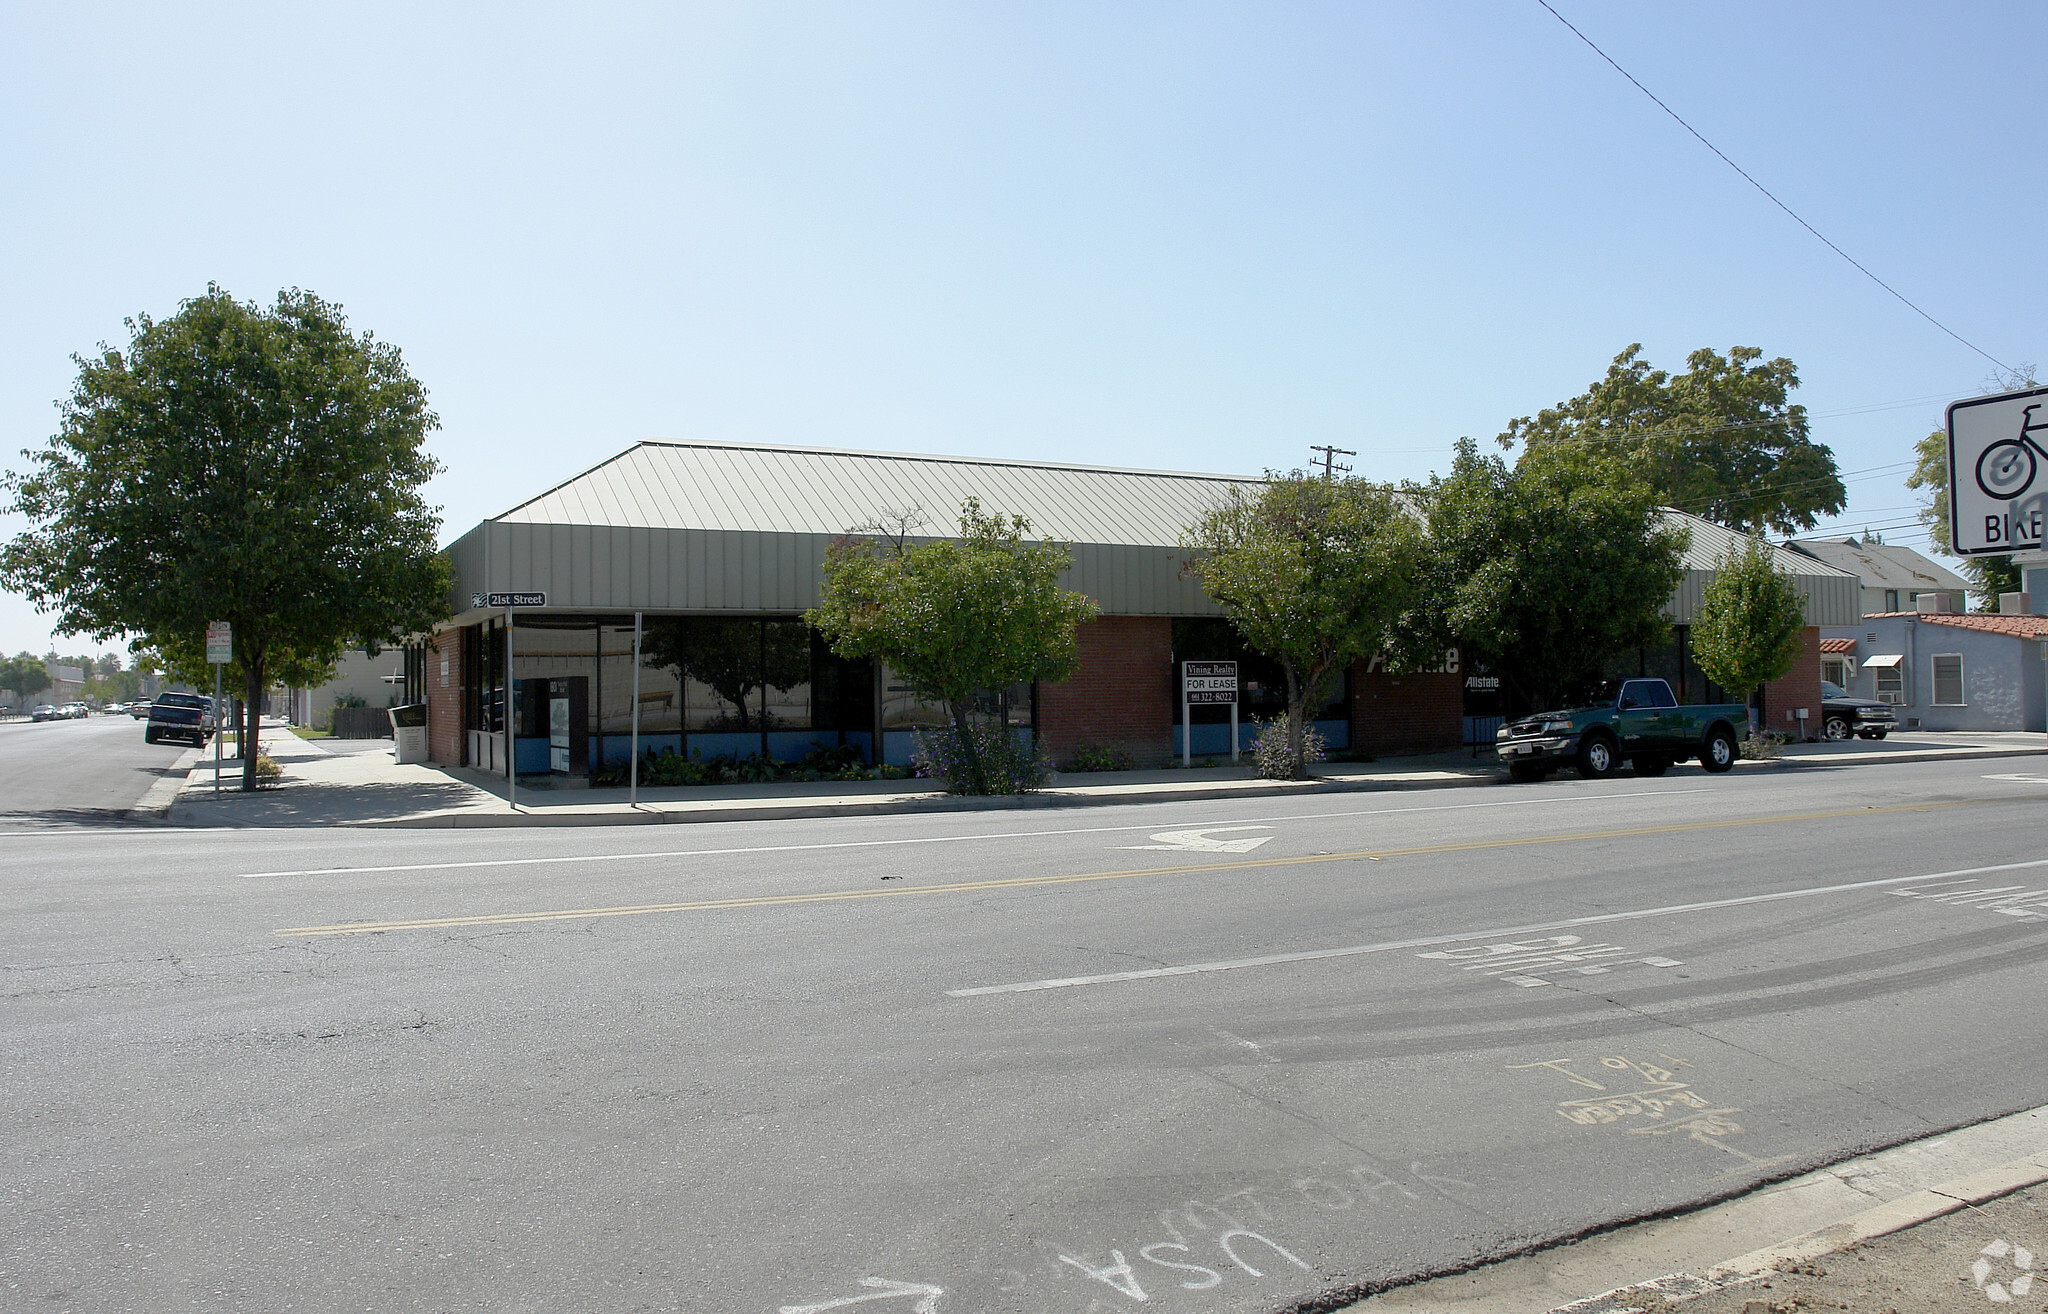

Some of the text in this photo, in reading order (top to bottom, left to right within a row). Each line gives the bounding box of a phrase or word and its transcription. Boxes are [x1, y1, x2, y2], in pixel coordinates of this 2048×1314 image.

[1985, 511, 2043, 543] BIKE
[491, 594, 543, 605] 21st Street
[1188, 664, 1235, 675] Vining Realty
[1187, 679, 1236, 689] FOR LEASE
[1465, 676, 1500, 688] Allstate
[1200, 692, 1233, 702] 322-8022
[1057, 1228, 1312, 1302] USA
